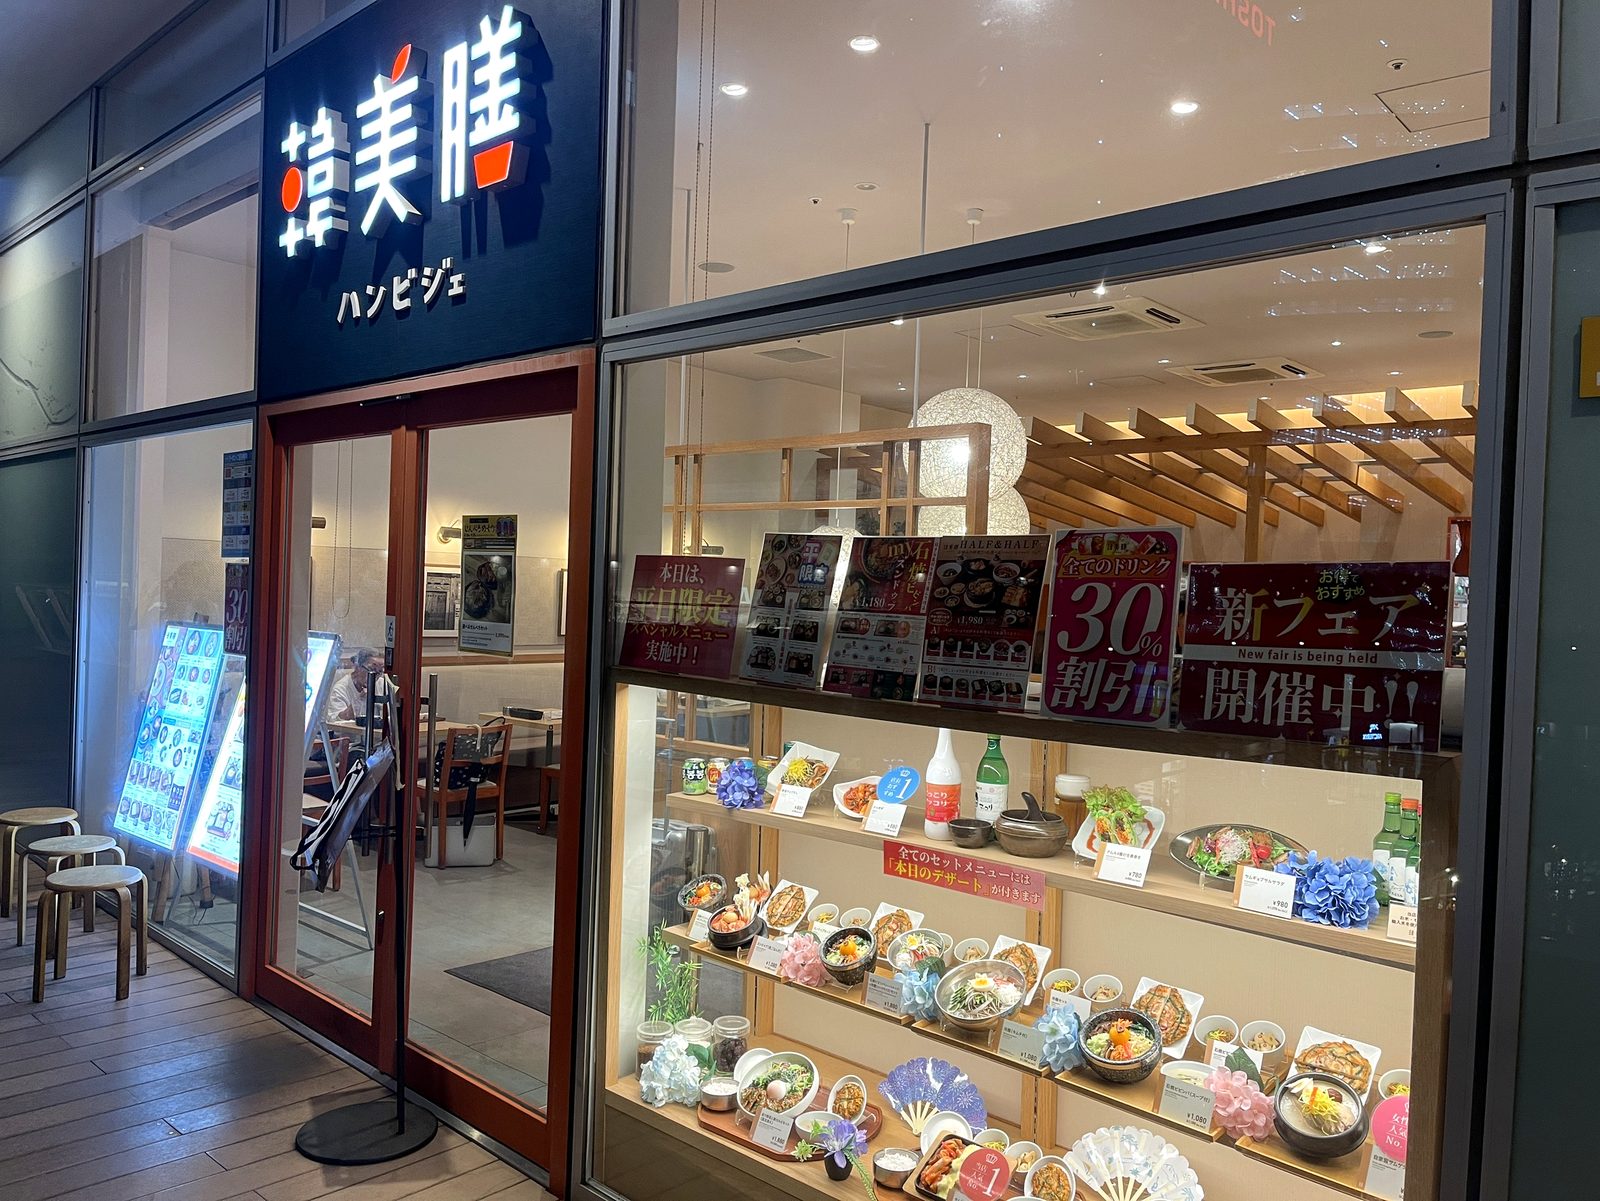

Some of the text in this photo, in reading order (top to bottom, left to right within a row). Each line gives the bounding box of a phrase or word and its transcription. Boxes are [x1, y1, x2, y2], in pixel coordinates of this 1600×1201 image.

[336, 256, 467, 324] ハンビジェ
[659, 562, 704, 584] 本日は、
[1063, 557, 1171, 576] 全てのドリンク
[634, 586, 734, 628] 平日限定
[1315, 585, 1366, 601] おすすめ
[629, 623, 729, 641] スペシャルメニュー
[1056, 582, 1164, 657] 30%
[1213, 587, 1421, 643] 新フェア
[1238, 649, 1378, 665] New fair is being held
[1050, 656, 1159, 715] 割引
[898, 846, 1032, 885] 全てのセットメニューには
